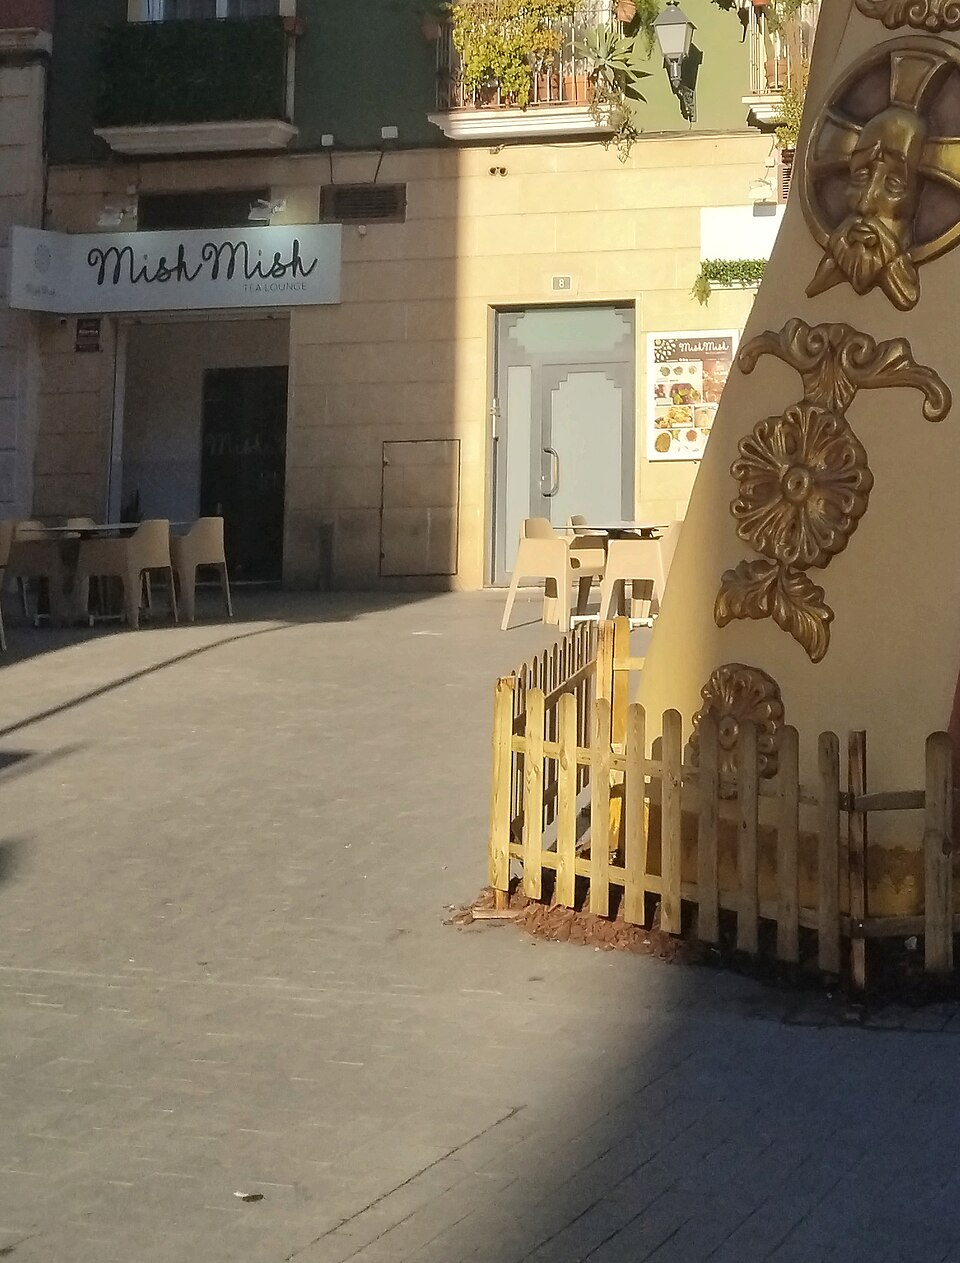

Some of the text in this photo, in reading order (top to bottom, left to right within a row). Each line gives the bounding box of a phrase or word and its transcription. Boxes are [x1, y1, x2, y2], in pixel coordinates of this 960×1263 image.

[87, 239, 318, 285] Mish Mish
[264, 281, 307, 292] LOUNGE
